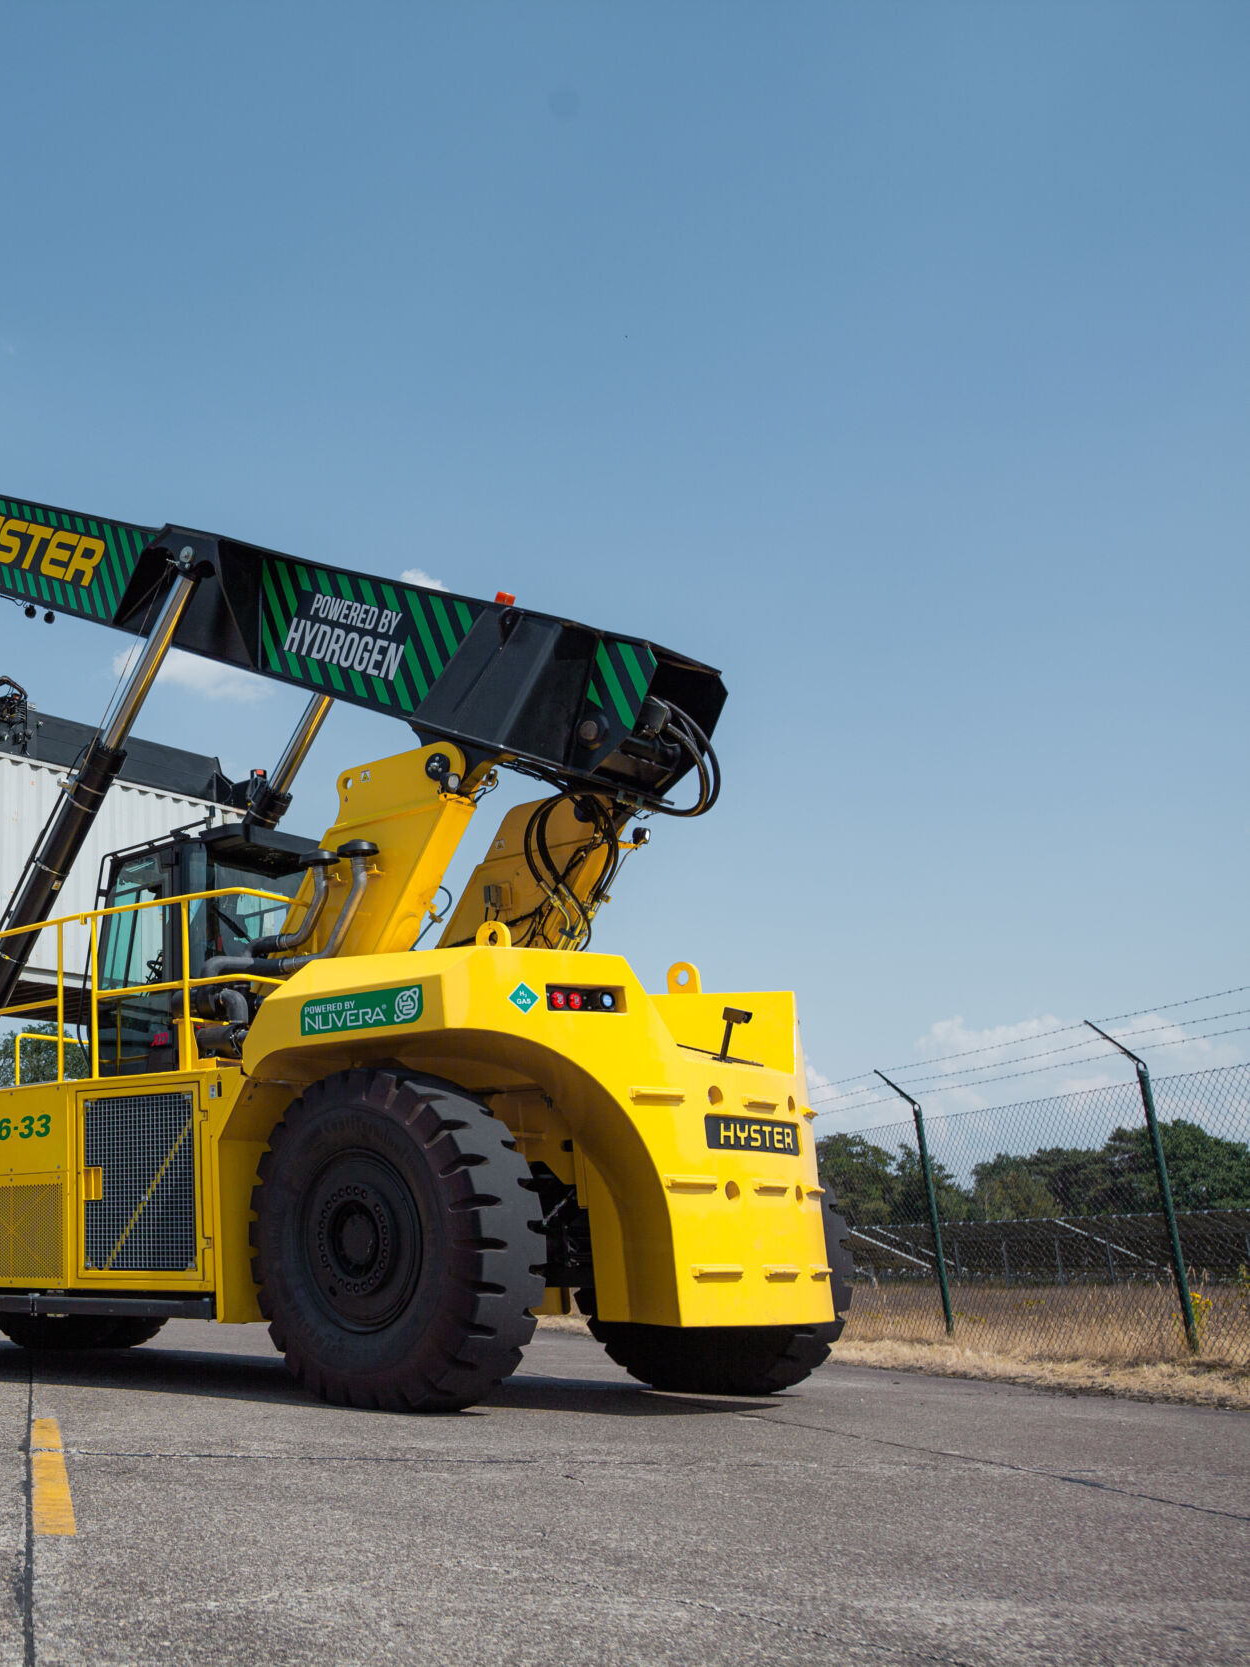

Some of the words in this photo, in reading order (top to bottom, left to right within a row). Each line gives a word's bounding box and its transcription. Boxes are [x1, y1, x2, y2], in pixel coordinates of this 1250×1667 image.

[310, 593, 378, 630] POWERED
[378, 609, 402, 635] BY
[283, 617, 405, 681] HYDROGEN
[304, 1002, 342, 1015] POWERED
[344, 1000, 356, 1009] BY
[720, 1123, 793, 1150] HYSTER
